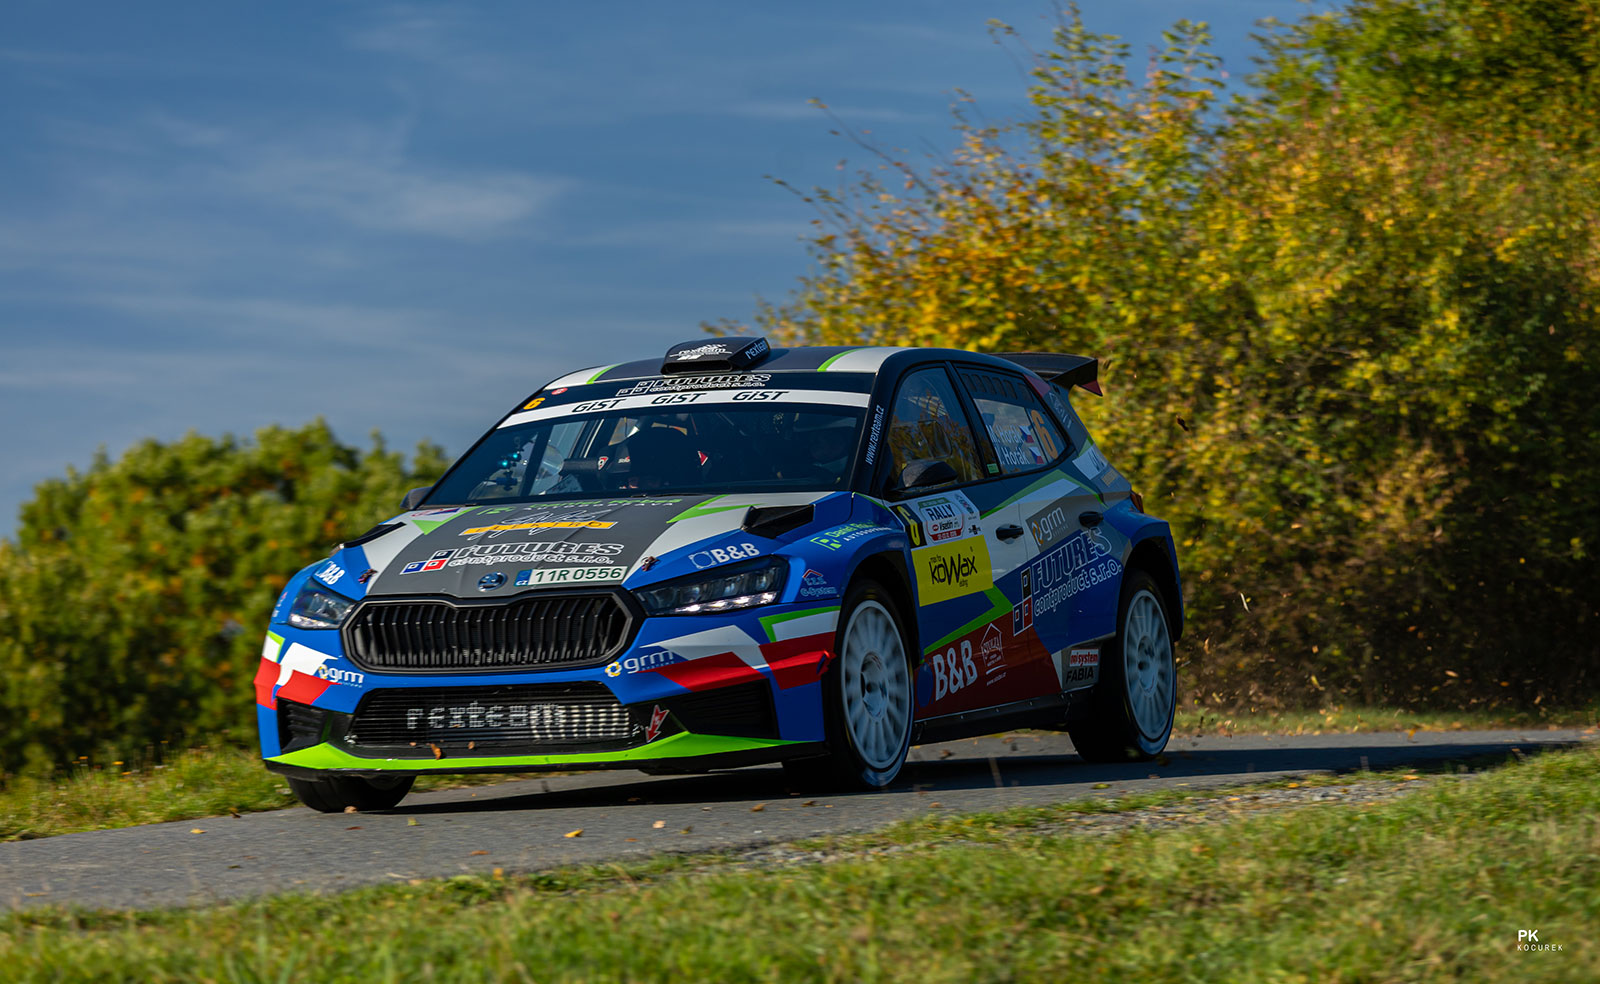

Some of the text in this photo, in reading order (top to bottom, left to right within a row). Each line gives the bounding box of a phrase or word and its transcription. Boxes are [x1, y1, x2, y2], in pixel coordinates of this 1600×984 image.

[523, 397, 545, 410] 6
[865, 404, 885, 465] www.rexteam.cz
[1031, 409, 1059, 460] 6
[925, 503, 956, 521] RALLY
[897, 505, 921, 546] 6
[1040, 507, 1066, 541] grm
[451, 541, 625, 557] FUTURES
[711, 542, 760, 563] B&B
[1032, 526, 1112, 595] FUTURES
[535, 570, 570, 583] 11R
[573, 568, 622, 580] 0556
[624, 650, 674, 674] grm
[933, 639, 978, 701] B&B
[328, 667, 364, 684] grm
[1066, 667, 1094, 684] FABIA
